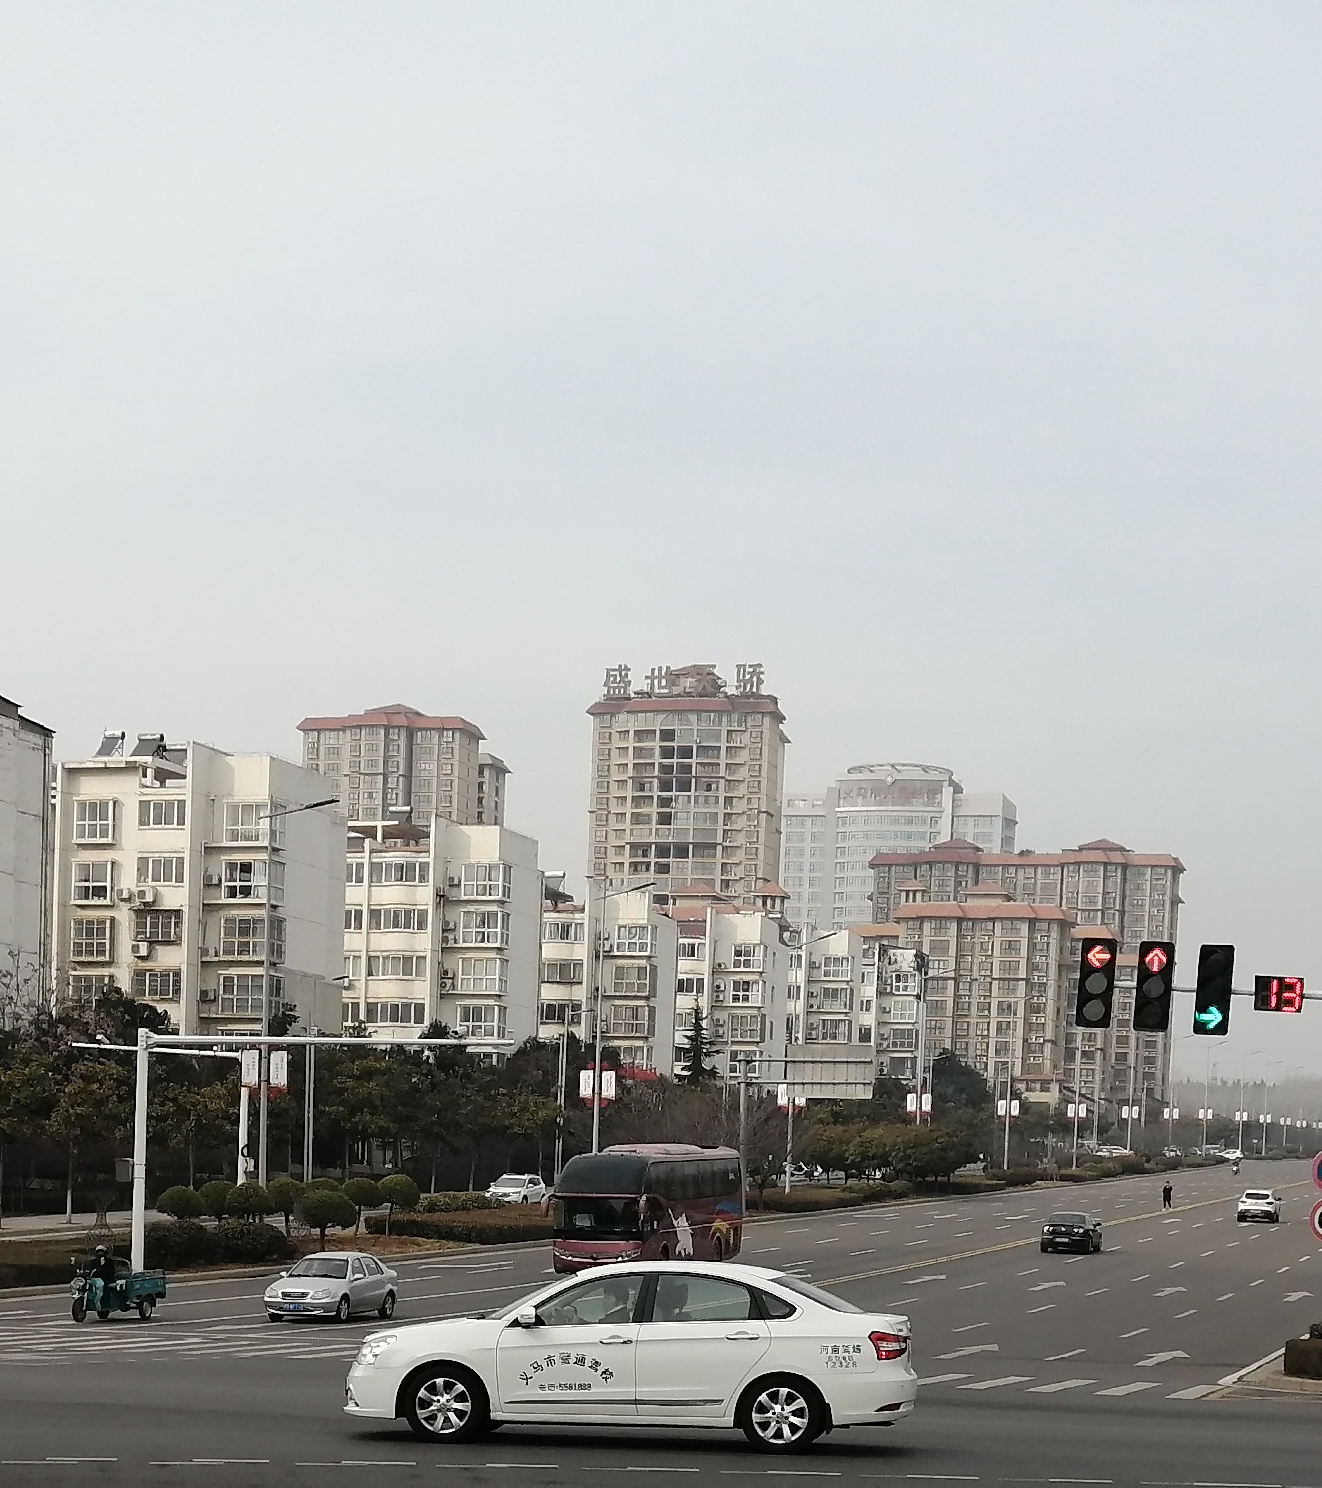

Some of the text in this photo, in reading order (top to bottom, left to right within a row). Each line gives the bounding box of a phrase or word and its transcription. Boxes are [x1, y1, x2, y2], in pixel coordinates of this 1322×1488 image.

[602, 663, 765, 697] 盛世天骄
[1269, 977, 1301, 1012] 13
